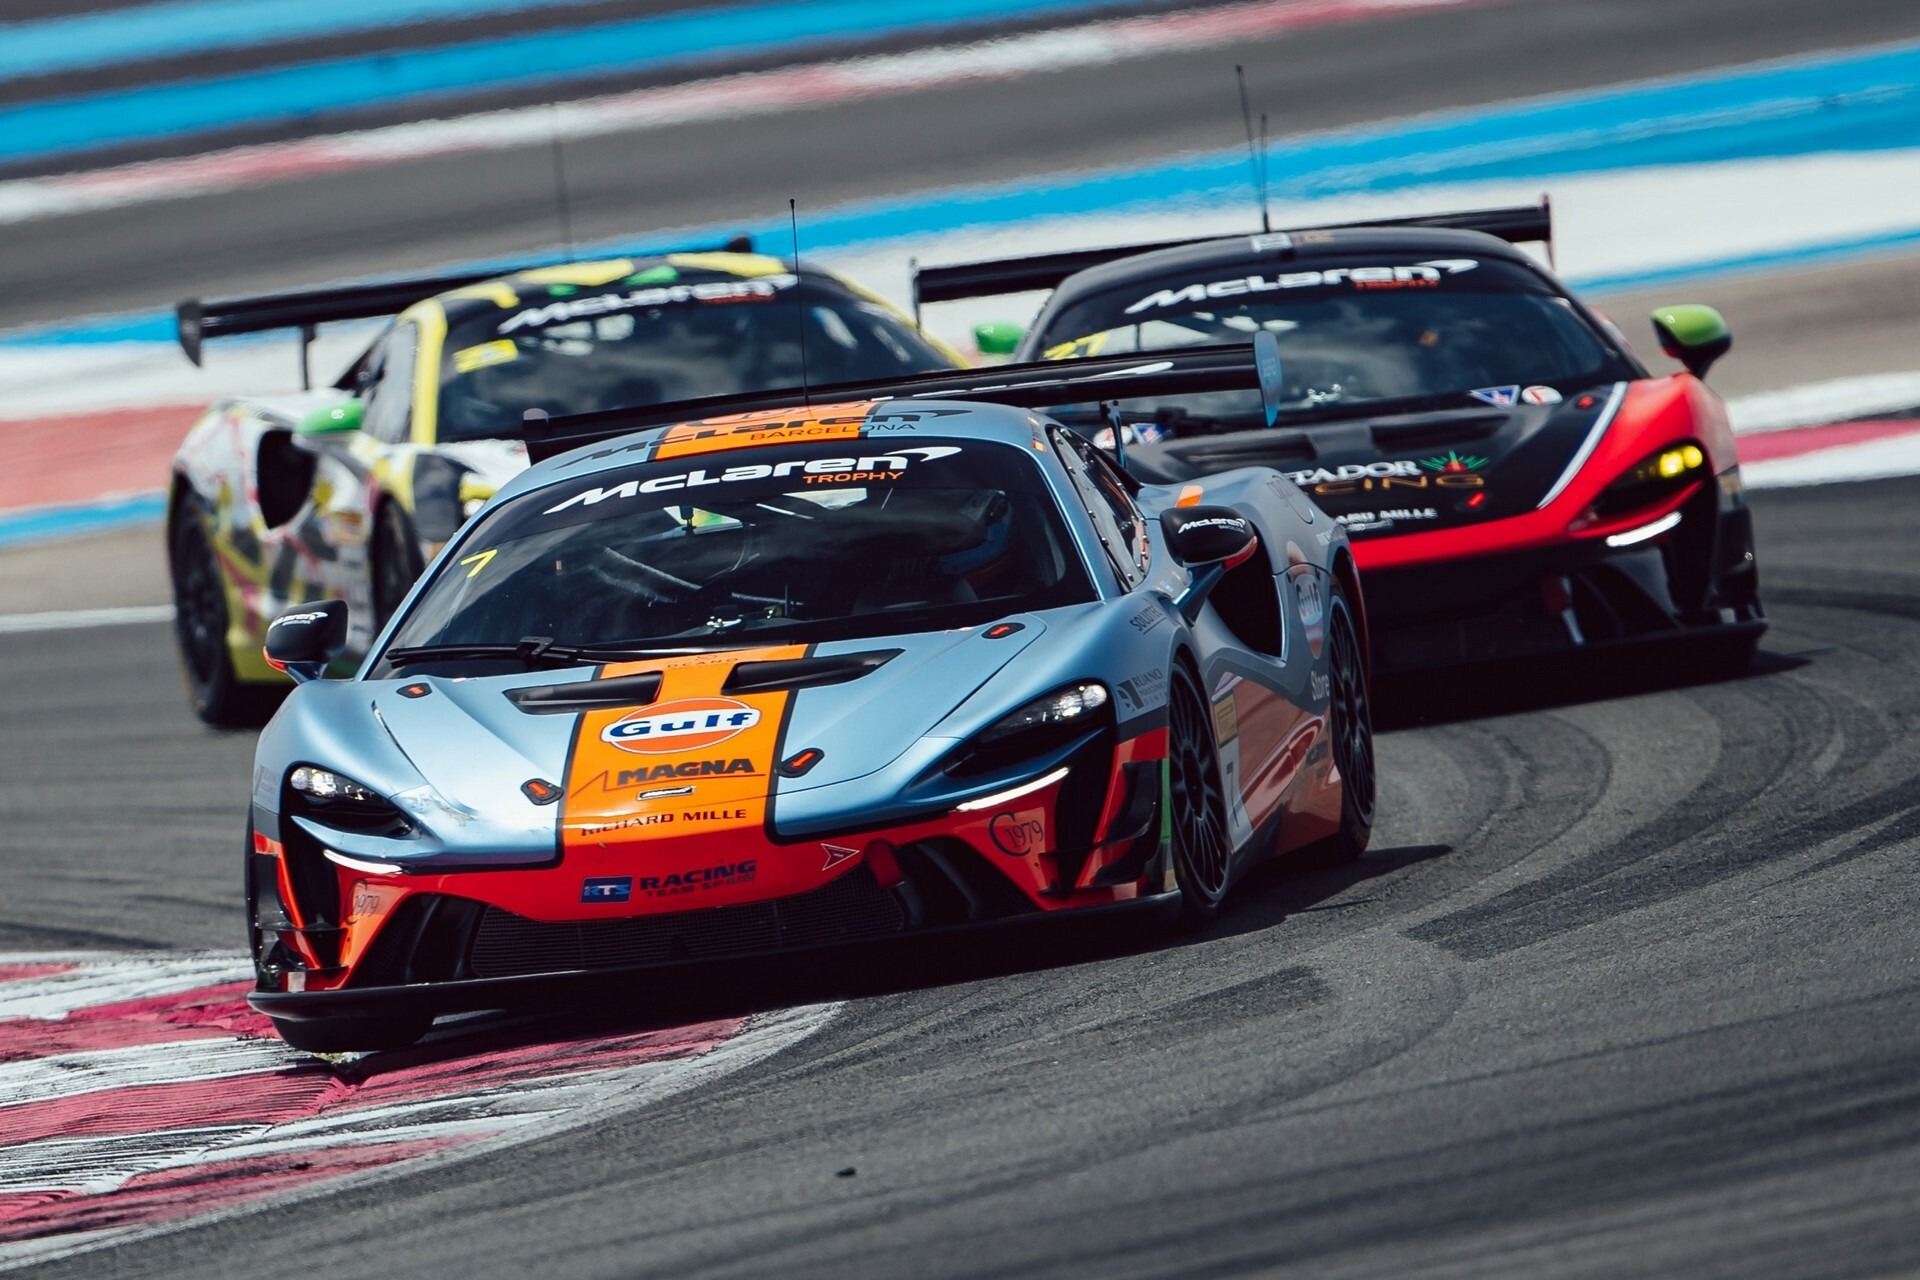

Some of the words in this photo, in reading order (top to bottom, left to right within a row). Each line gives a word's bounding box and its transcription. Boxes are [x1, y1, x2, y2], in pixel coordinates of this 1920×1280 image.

[1123, 258, 1479, 314] McLaren
[553, 410, 973, 470] McLaren
[750, 422, 917, 441] BARCELONA
[543, 446, 962, 515] McLaren
[803, 471, 904, 484] TROPHY
[1284, 460, 1423, 486] TADOR
[1314, 475, 1485, 496] CING
[1178, 518, 1246, 534] McLaren
[460, 549, 497, 578] 7
[609, 712, 752, 737] Gulf
[617, 758, 755, 786] MAGNA
[581, 813, 674, 836] RICHARD
[683, 809, 747, 821] MILLE
[640, 860, 756, 890] RACING
[583, 884, 630, 896] RTS
[647, 885, 695, 898] TEAM
